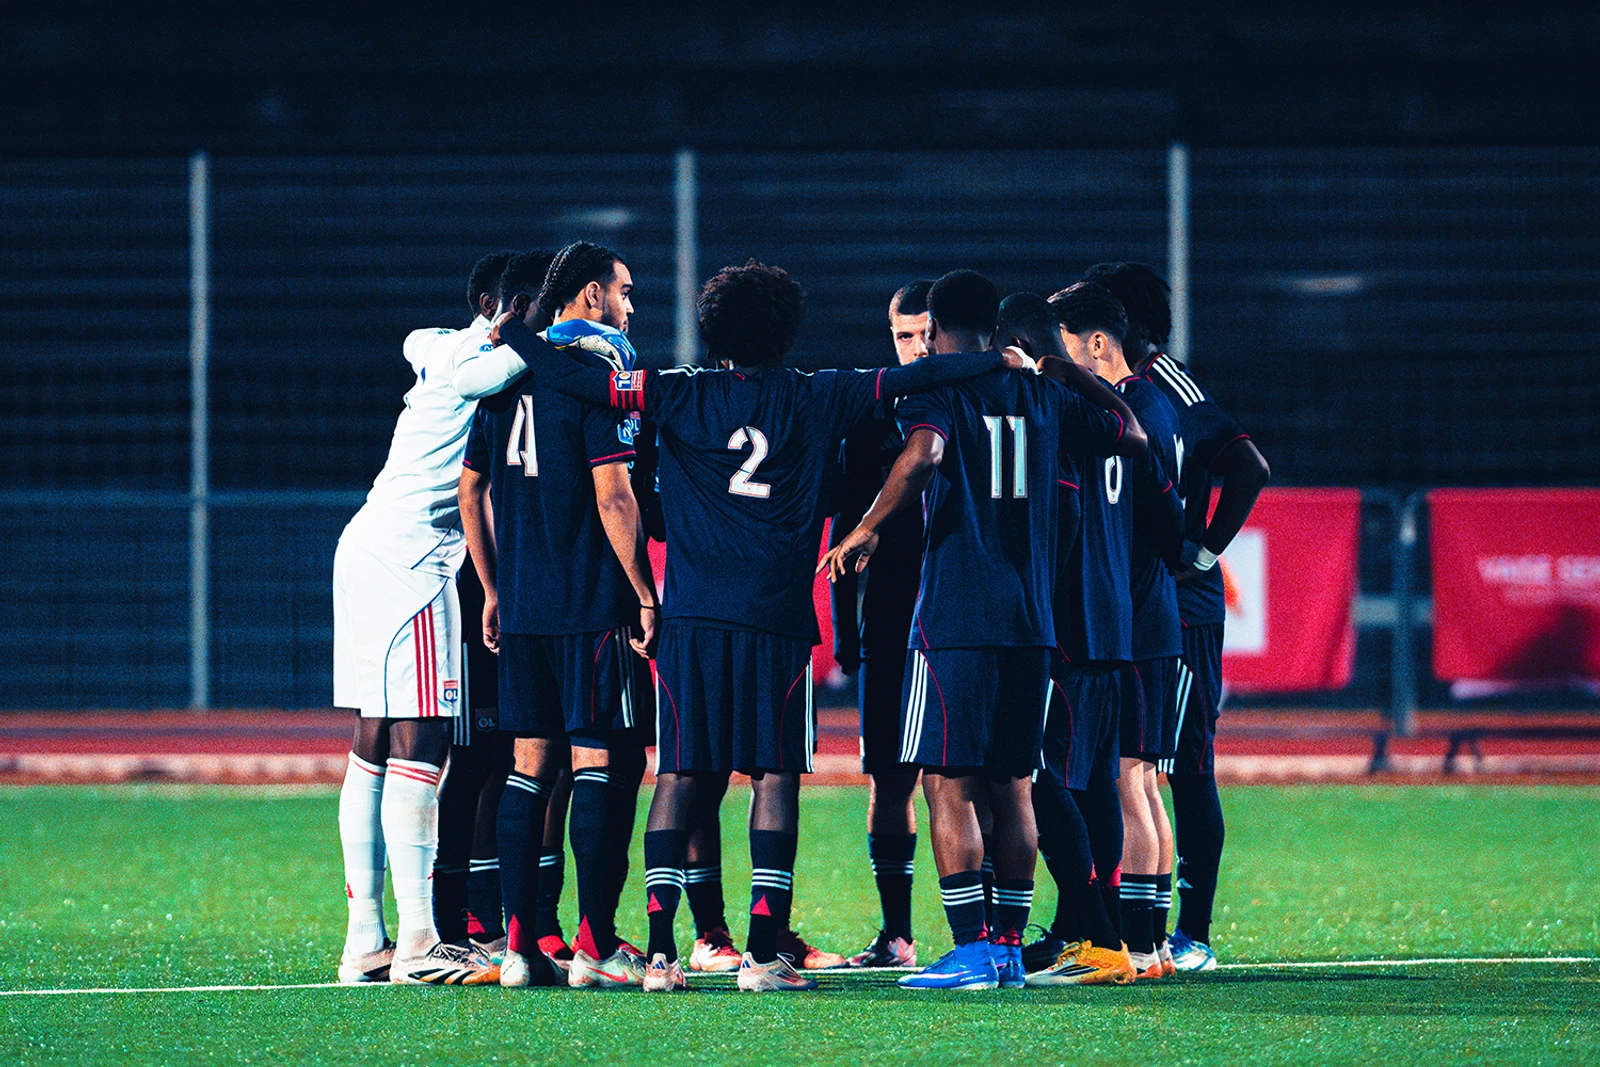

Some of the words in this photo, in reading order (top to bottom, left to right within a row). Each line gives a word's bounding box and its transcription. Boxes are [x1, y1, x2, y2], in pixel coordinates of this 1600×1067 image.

[506, 394, 538, 477] 4
[727, 425, 771, 499] 2
[982, 415, 1028, 499] 11
[444, 689, 458, 700] OL
